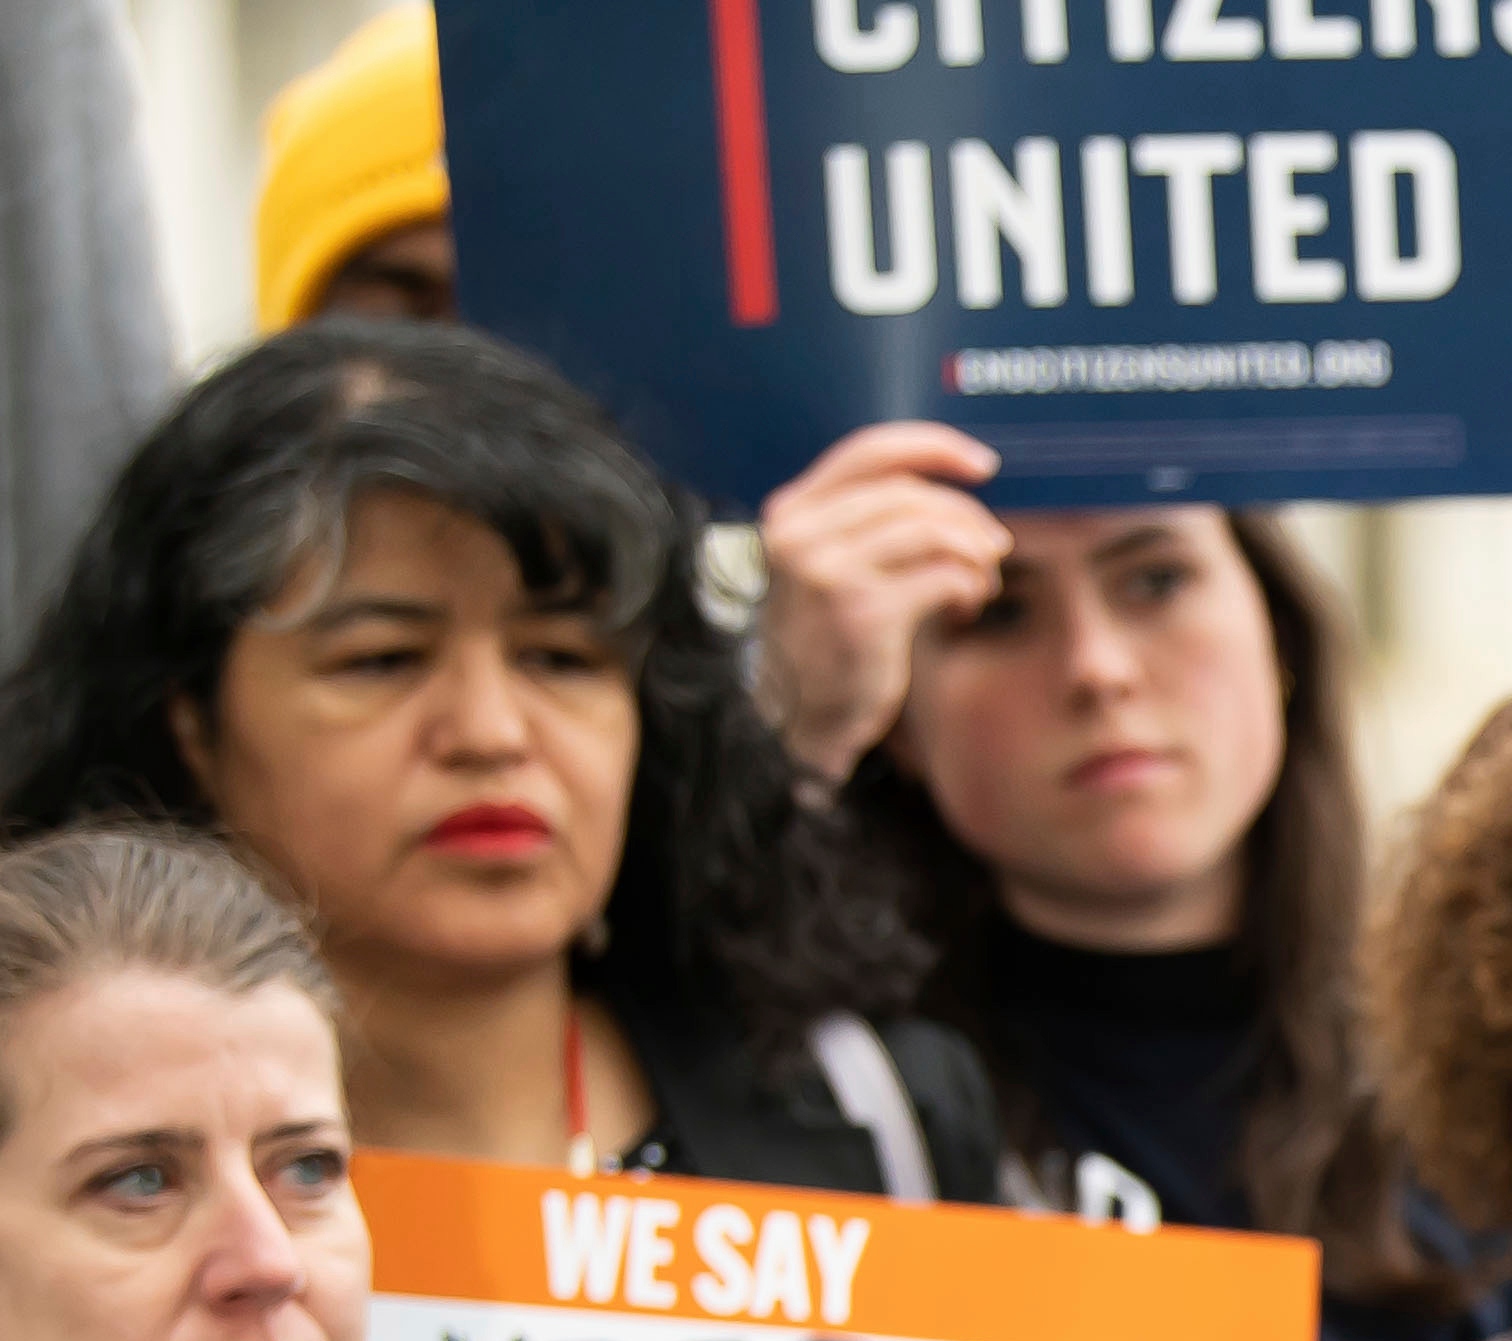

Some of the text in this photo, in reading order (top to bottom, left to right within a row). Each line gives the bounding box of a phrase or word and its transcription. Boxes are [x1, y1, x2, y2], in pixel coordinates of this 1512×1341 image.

[823, 130, 1463, 317] UNITED
[541, 1189, 871, 1325] WE SAY
